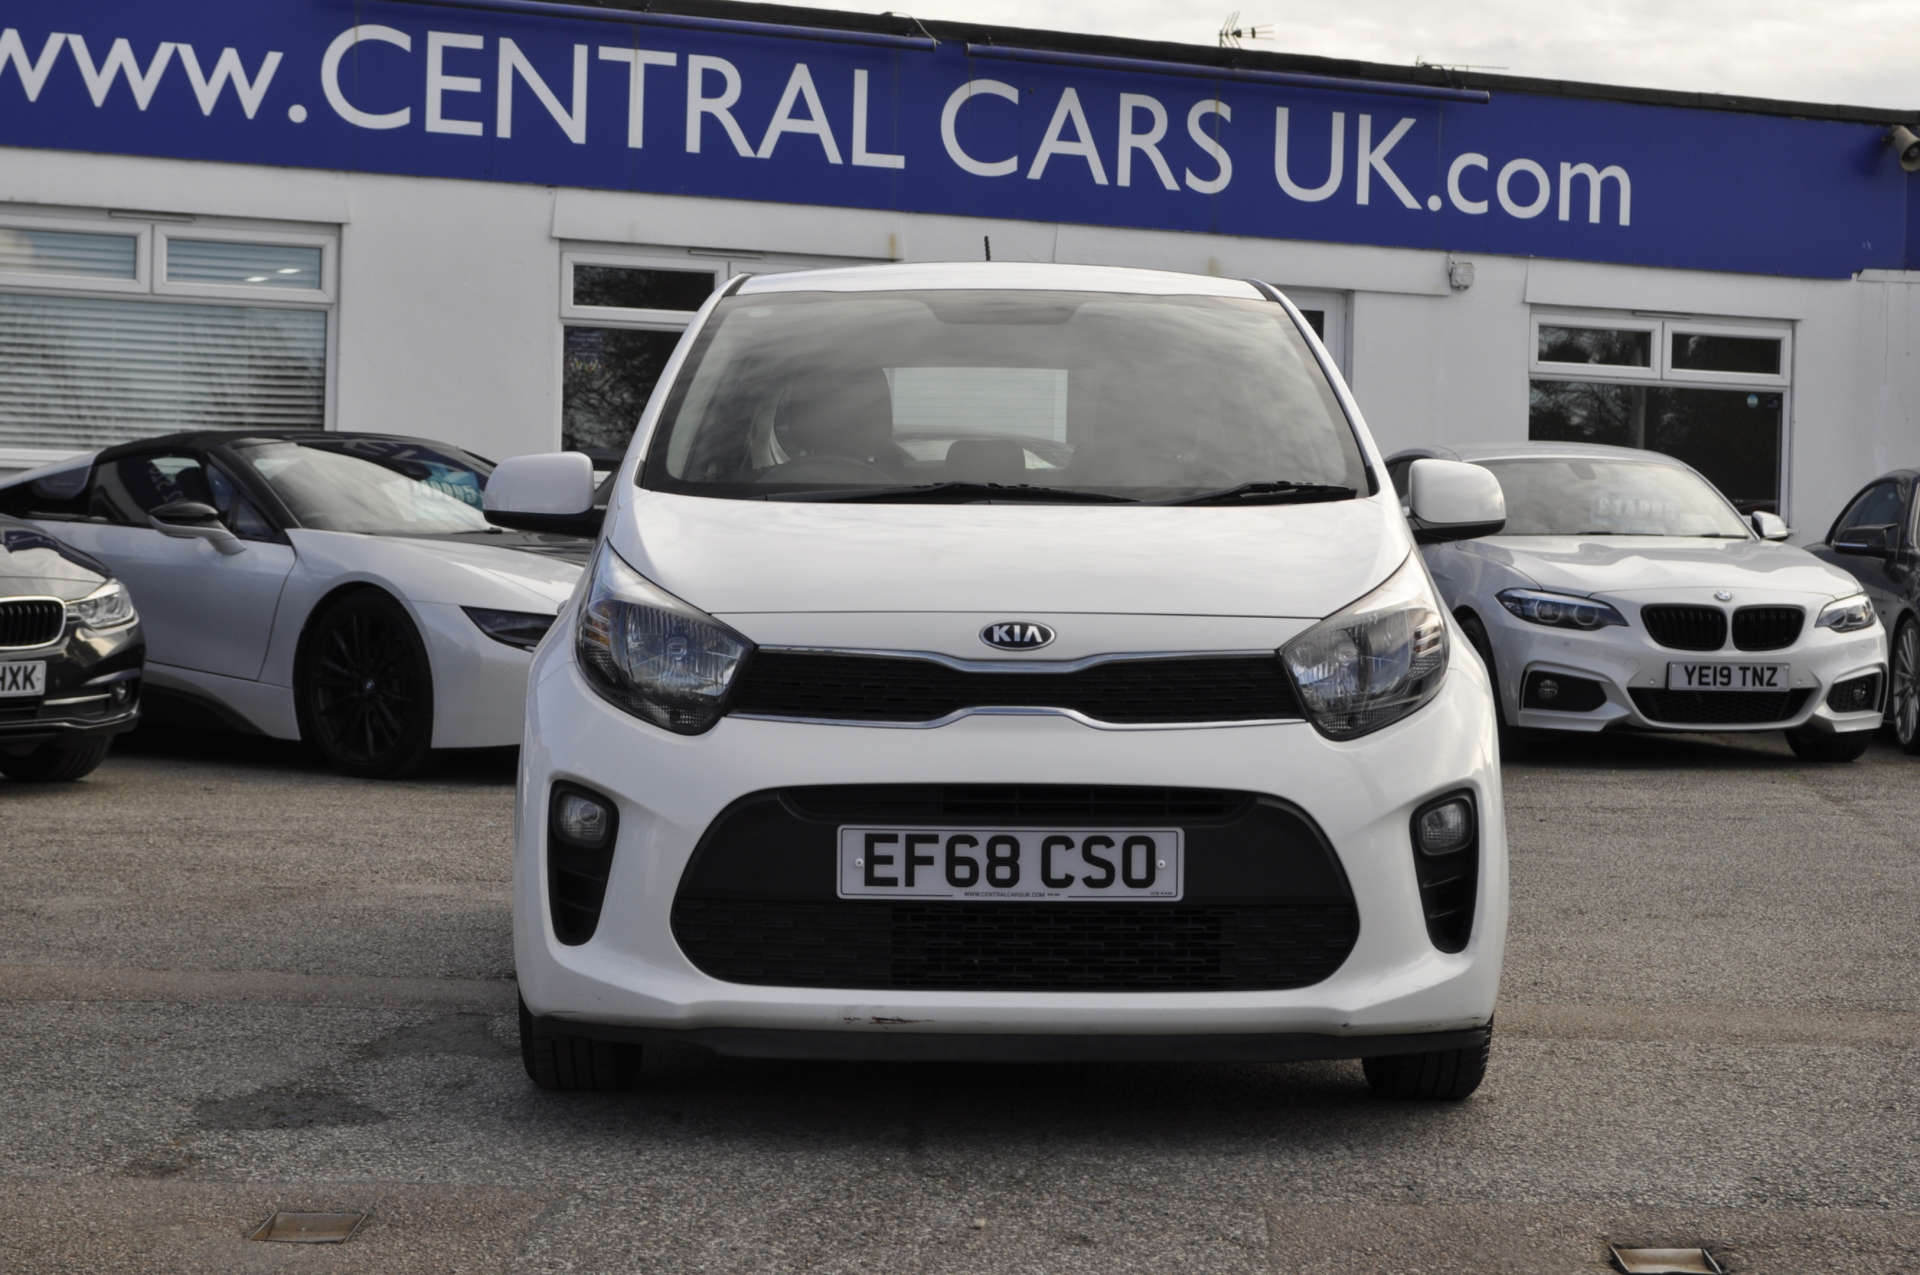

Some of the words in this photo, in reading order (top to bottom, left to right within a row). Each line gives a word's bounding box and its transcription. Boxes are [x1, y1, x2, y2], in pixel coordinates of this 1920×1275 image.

[940, 79, 1234, 195] CARS
[1274, 106, 1632, 227] UK.com
[992, 624, 1043, 643] KIA
[1684, 665, 1732, 687] YE19
[1738, 666, 1779, 687] TNZ
[863, 833, 1021, 889] EF68
[1040, 835, 1157, 890] CSO
